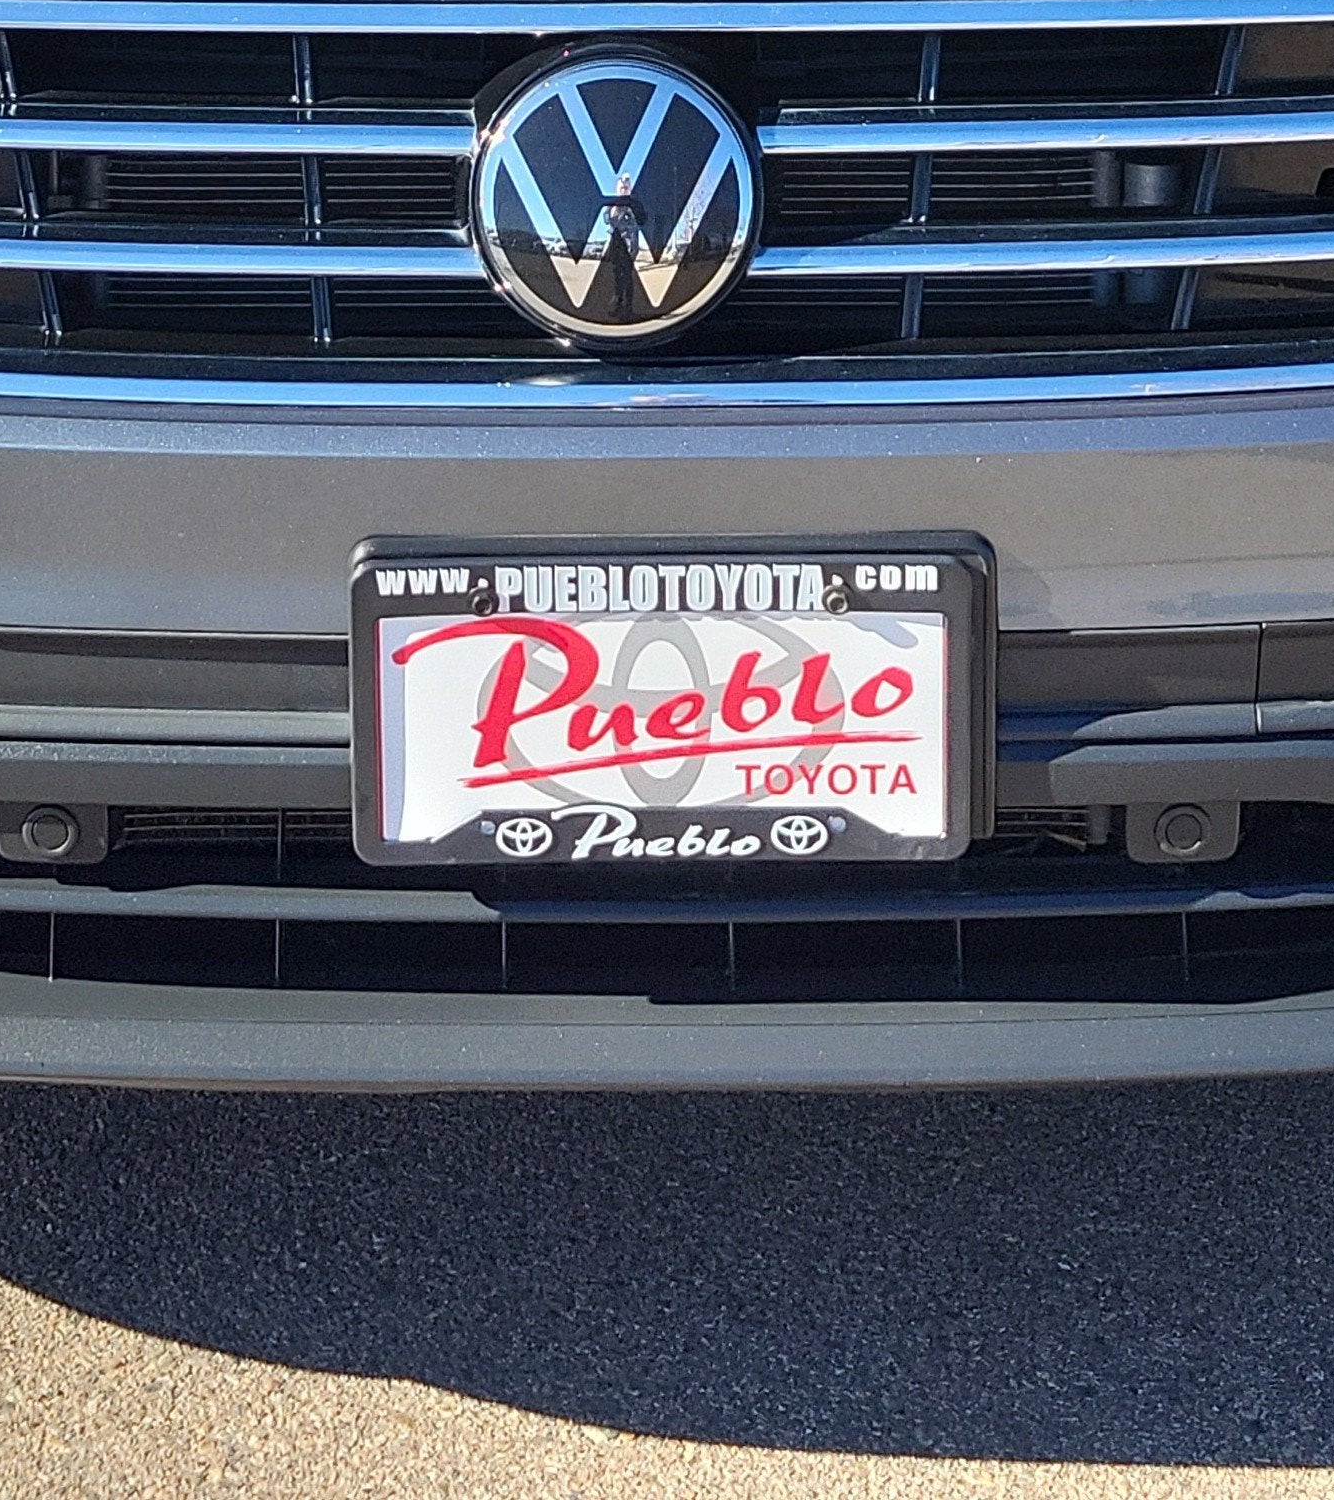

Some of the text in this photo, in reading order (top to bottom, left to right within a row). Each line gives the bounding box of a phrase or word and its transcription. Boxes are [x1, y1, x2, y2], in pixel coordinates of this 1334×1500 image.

[391, 616, 914, 768] Pueblo
[735, 763, 917, 796] TOYOTA
[550, 804, 763, 859] Pueblo
